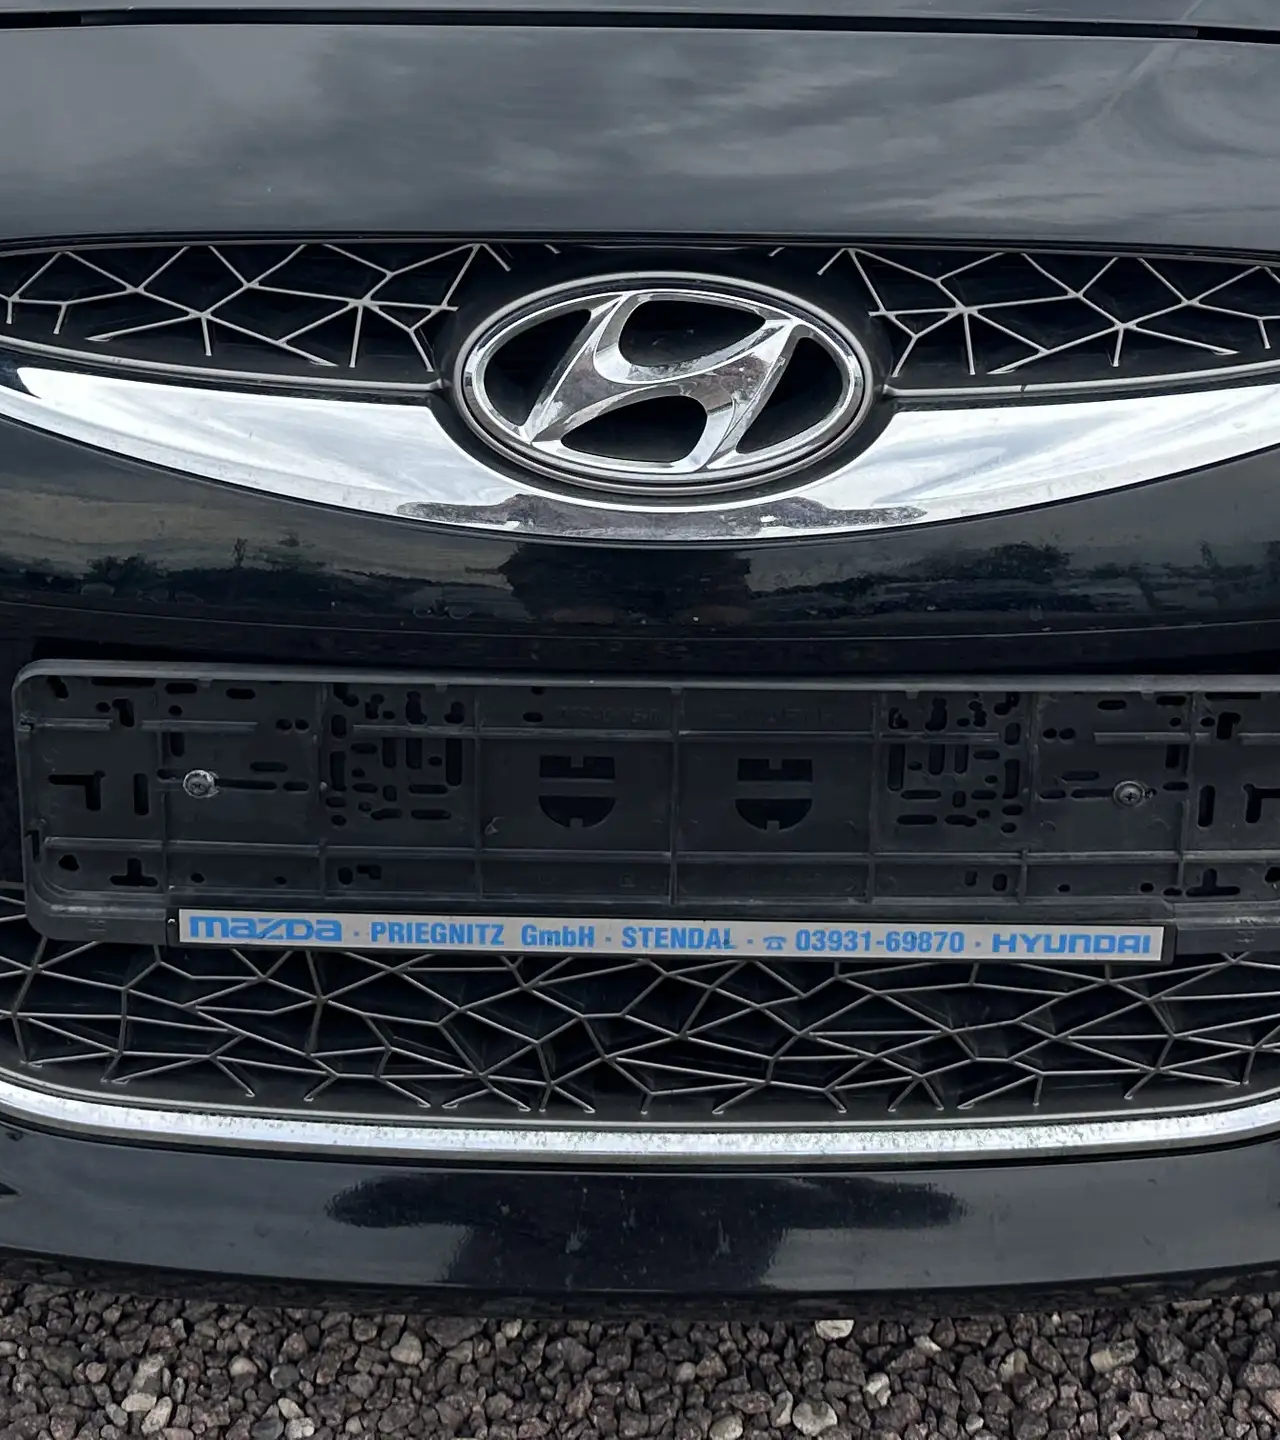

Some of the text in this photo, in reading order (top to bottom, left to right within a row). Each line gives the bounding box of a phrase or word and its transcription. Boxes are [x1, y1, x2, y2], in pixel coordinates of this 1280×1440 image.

[370, 921, 505, 946] PRIEGNITZ
[521, 924, 595, 948] GmbH
[621, 926, 738, 950] STENDAL
[795, 928, 965, 953] 03931-69870
[992, 933, 1151, 954] HYUNDAI
